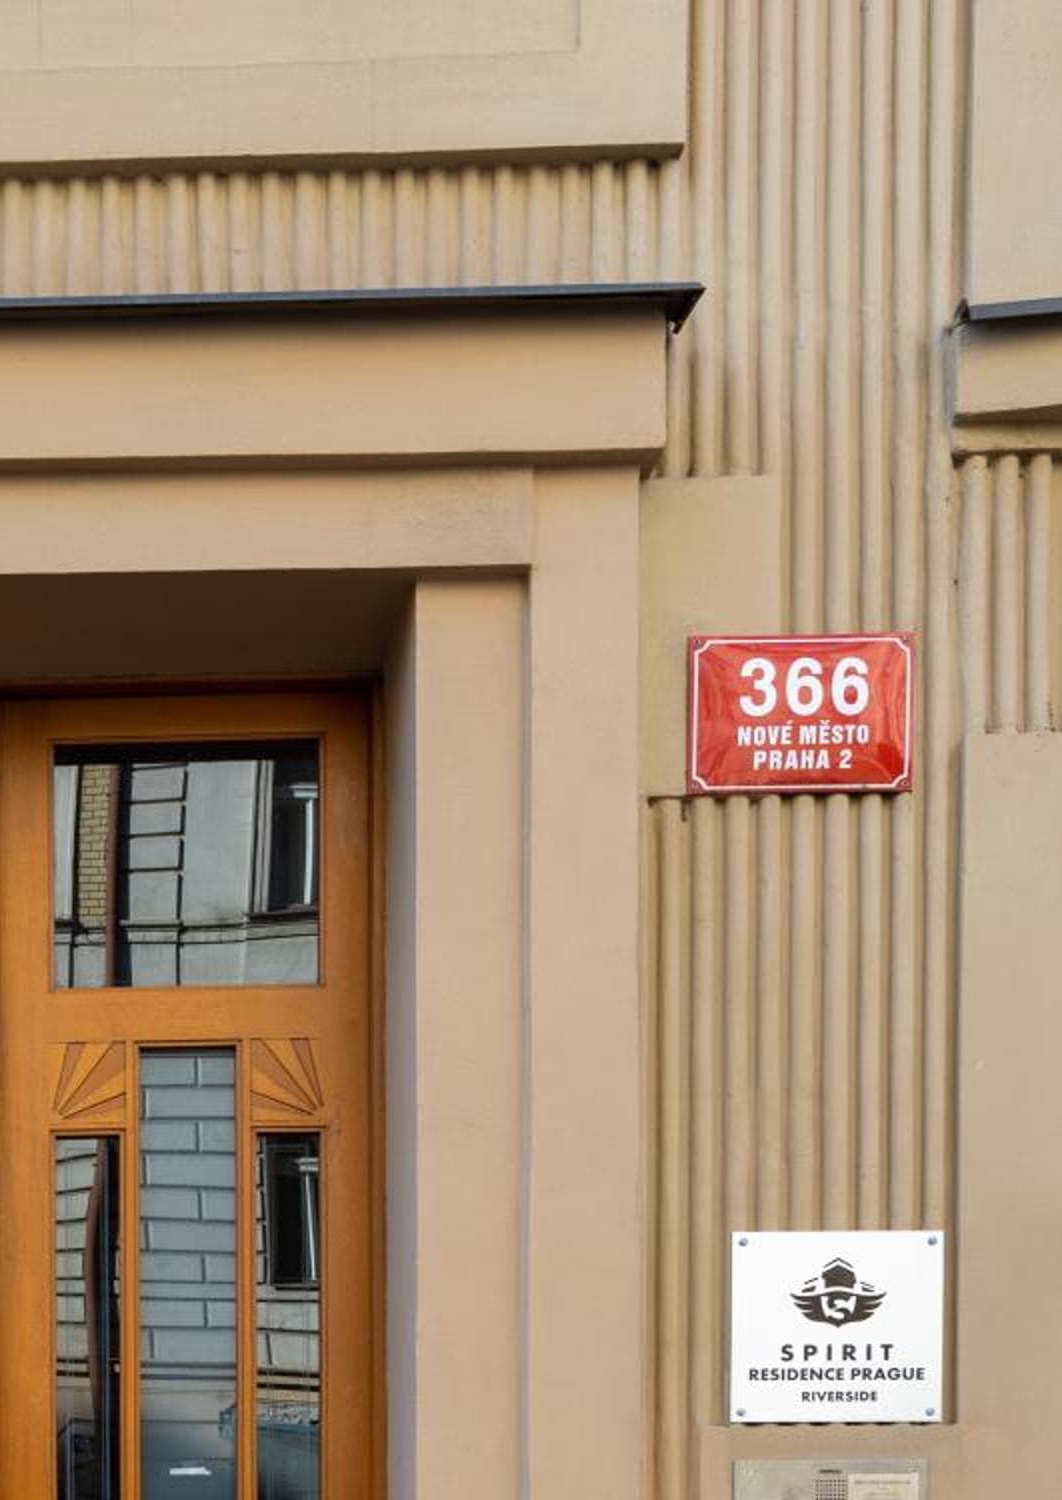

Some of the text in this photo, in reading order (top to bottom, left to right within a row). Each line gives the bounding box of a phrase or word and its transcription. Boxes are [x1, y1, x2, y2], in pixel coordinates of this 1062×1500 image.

[739, 656, 869, 717] 366
[737, 720, 869, 746] NOVÉ MĚSTO
[753, 749, 853, 771] PRAHA 2
[780, 1344, 894, 1361] SPIRIT
[748, 1367, 925, 1381] RESIDENCE PRAGUE
[801, 1391, 878, 1402] RIVERSIDE
